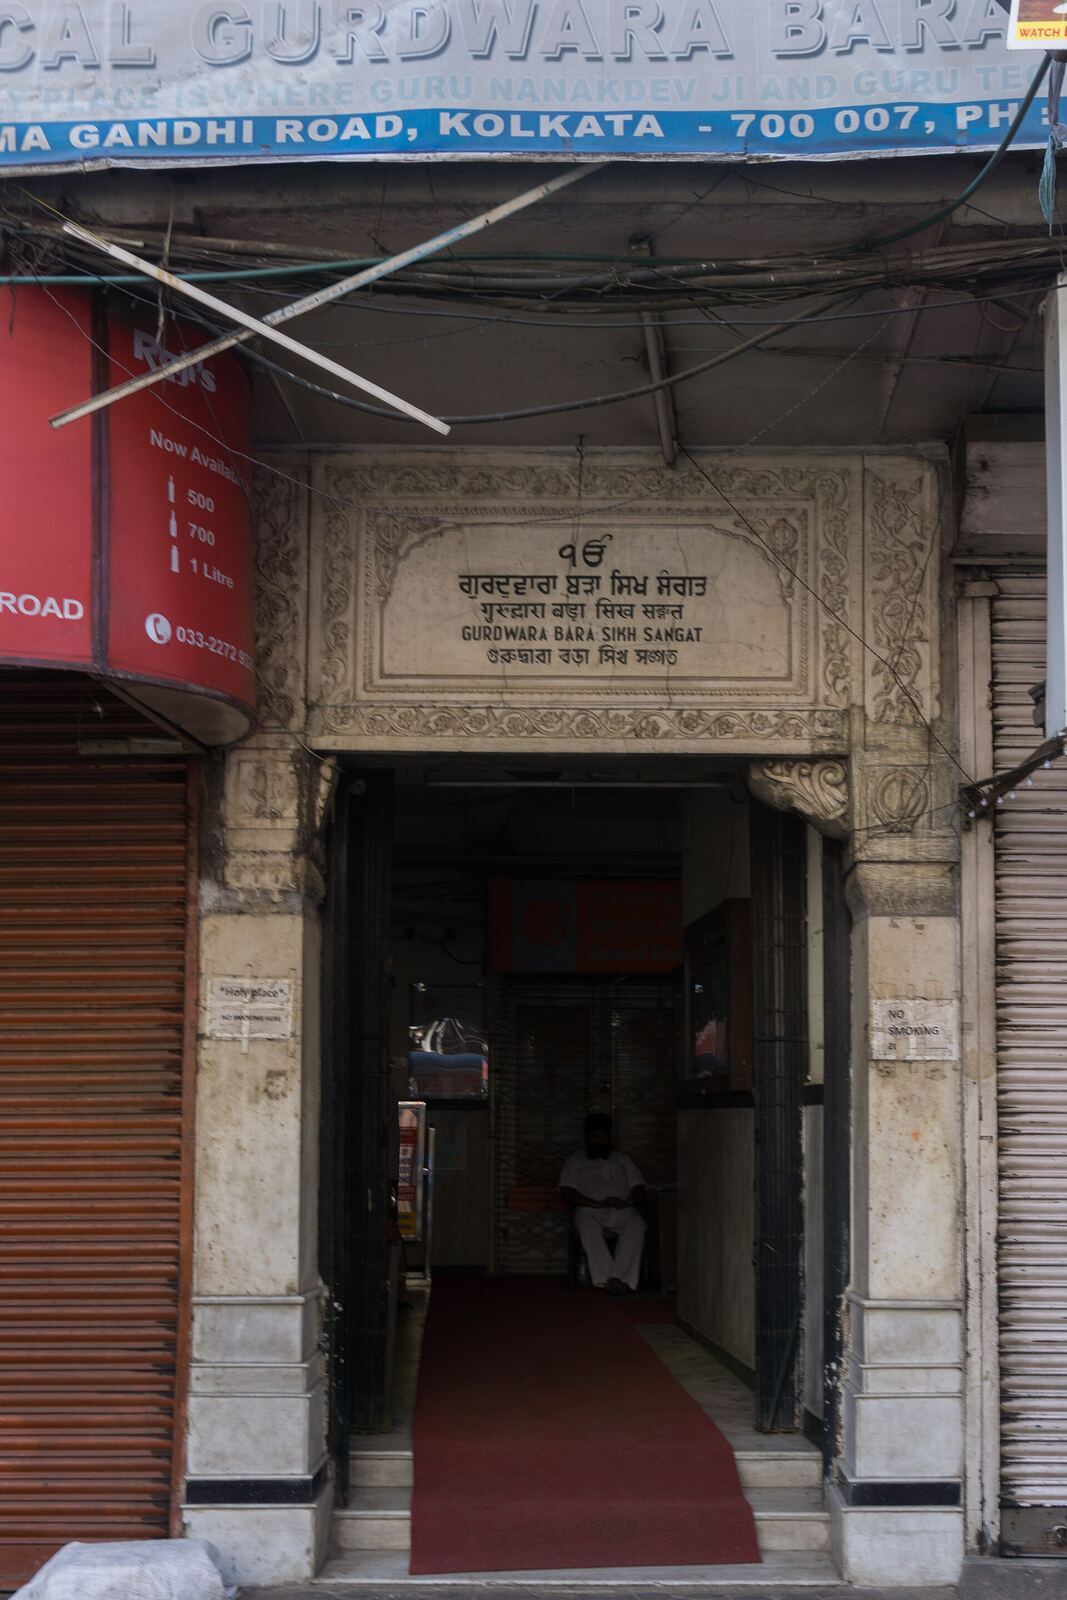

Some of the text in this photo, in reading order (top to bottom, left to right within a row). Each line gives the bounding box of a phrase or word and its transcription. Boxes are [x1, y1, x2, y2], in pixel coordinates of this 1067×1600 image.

[191, 0, 734, 66] GURDWARA
[1019, 28, 1060, 37] WATCH
[44, 86, 158, 113] PLACE
[175, 82, 209, 108] IS
[223, 80, 354, 107] WHERE
[369, 75, 473, 103] GURU
[490, 78, 697, 103] NANAKDEV
[712, 76, 743, 102] JI
[760, 74, 838, 102] AND
[853, 67, 958, 97] GURU
[69, 118, 254, 149] GANDHI
[275, 114, 418, 144] ROAD,
[439, 111, 664, 138] KOLKATA
[730, 112, 815, 138] 700
[834, 105, 935, 135] 007,
[955, 102, 1020, 130] PH
[150, 428, 187, 458] Now
[187, 488, 215, 513] 500
[187, 522, 216, 546] 700
[189, 558, 235, 588] 1 Litre
[610, 569, 648, 597] ਸਿਖ
[0, 592, 85, 620] ROAD
[596, 598, 635, 621] सिख
[462, 626, 704, 643] GURDWARA BARA SIKH SANGAT
[599, 644, 629, 666] সিখ
[887, 1009, 905, 1019] NO
[888, 1025, 940, 1036] SMOKING
